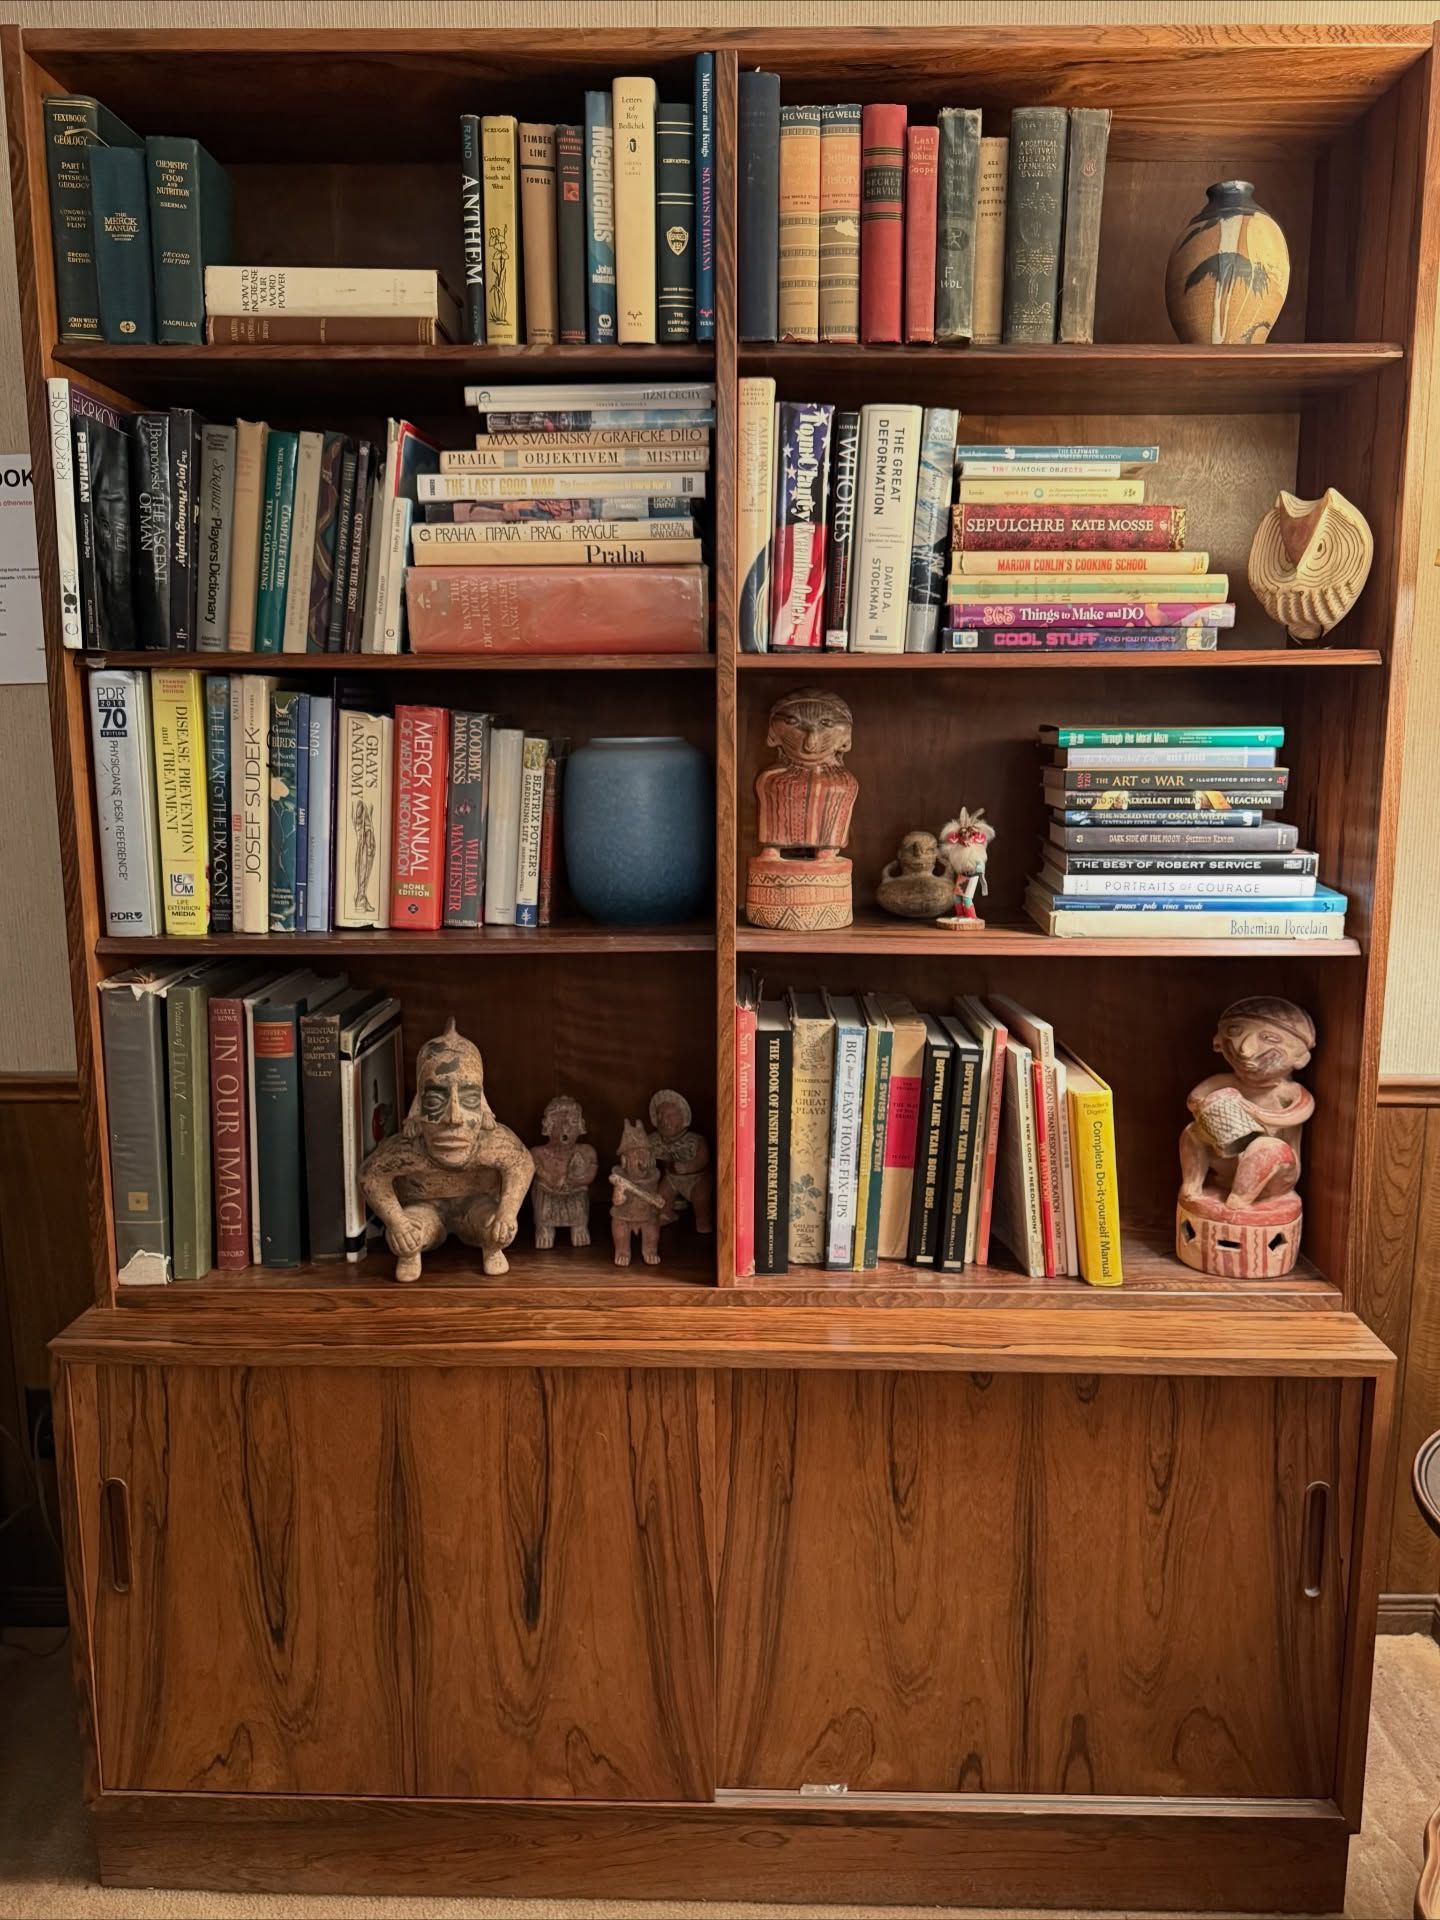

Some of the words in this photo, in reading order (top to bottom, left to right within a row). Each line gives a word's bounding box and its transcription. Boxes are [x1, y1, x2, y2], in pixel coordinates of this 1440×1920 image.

[621, 96, 643, 104] Letters
[53, 113, 87, 123] TEXTBOOK
[618, 122, 646, 130] Bedichek
[626, 113, 639, 121] Roy
[796, 113, 820, 121] WELLS
[836, 111, 861, 119] WELLS
[54, 134, 88, 146] GEOLOGY
[463, 124, 472, 159] RAND
[523, 134, 552, 144] TIMBER
[913, 136, 935, 145] Last
[155, 160, 188, 171] CHEMISTRY
[483, 156, 511, 164] Gardening
[529, 149, 547, 158] LINE
[162, 174, 184, 183] FOOD
[591, 126, 614, 243] Megatrends
[156, 187, 190, 198] NUTRITION
[104, 217, 138, 226] MERCK
[105, 225, 140, 233] MANUAL
[462, 175, 483, 285] ANTHEM
[595, 265, 613, 275] John
[250, 269, 259, 313] INCREASE
[259, 276, 268, 304] YOUR
[269, 274, 277, 308] WORD
[278, 273, 286, 309] POWER
[162, 320, 197, 328] MACMILLAN
[51, 391, 72, 481] KRKONOŠE
[895, 428, 905, 455] THE
[76, 431, 92, 504] PERMIAN
[448, 454, 497, 466] PRAHA
[524, 451, 619, 466] OBJEKTIVEM
[873, 420, 889, 516] DEFORMATION
[444, 478, 465, 496] THE
[468, 478, 496, 496] LAST
[499, 478, 528, 496] GOOD
[530, 478, 556, 496] WAR
[834, 436, 858, 543] WHORES
[890, 458, 903, 503] GREAT
[138, 492, 151, 511] OF
[265, 499, 273, 530] TEXAS
[140, 514, 153, 551] MAN
[435, 528, 477, 543] PRAHA
[530, 526, 562, 541] PRAG
[571, 524, 619, 540] PRAGUE
[966, 519, 1065, 533] SEPULCHRE
[1071, 520, 1105, 532] KATE
[1108, 519, 1154, 532] MOSSE
[209, 518, 223, 562] Players
[261, 533, 271, 591] GARDENING
[584, 544, 646, 565] Praha
[997, 559, 1031, 572] MARION
[1033, 558, 1073, 572] CONLIN'S
[1075, 558, 1114, 571] COOKING
[1115, 558, 1149, 571] SCHOOL
[204, 563, 222, 625] Dictionary
[868, 558, 882, 620] STOCKMAN
[882, 566, 894, 598] DAVID
[480, 580, 493, 648] DICTIONARY
[882, 602, 892, 613] A.
[983, 606, 1016, 625] 365
[1019, 607, 1060, 624] Things
[1061, 610, 1070, 619] to
[1071, 607, 1104, 620] Make
[1106, 608, 1121, 619] and
[1122, 607, 1144, 620] DO
[97, 687, 126, 700] PDR
[98, 708, 127, 729] 70
[400, 719, 413, 736] OF
[161, 726, 173, 746] and
[176, 706, 190, 764] DISEASE
[271, 736, 297, 748] BIRDS
[351, 719, 365, 800] ANATOMY
[365, 735, 380, 788] GRAY'S
[412, 720, 433, 788] MERCK
[453, 715, 468, 785] DARKNESS
[244, 728, 261, 806] SUDEK
[399, 738, 413, 791] MEDICAL
[163, 749, 179, 833] TREATMENT
[1111, 775, 1139, 787] ART
[1154, 775, 1185, 786] WAR
[113, 800, 124, 823] DESK
[178, 768, 195, 855] PREVENTION
[530, 775, 542, 823] BEATRIX
[1226, 796, 1272, 805] MEACHAM
[244, 810, 262, 882] JOSEF
[397, 794, 412, 876] INFORMATION
[411, 792, 431, 876] MANUAL
[116, 825, 128, 878] REFERENCE
[528, 825, 541, 878] POTTER'S
[449, 823, 464, 912] MANCHESTER
[463, 838, 479, 897] WILLIAM
[1075, 861, 1099, 869] THE
[1103, 861, 1133, 869] BEST
[1136, 861, 1154, 869] OF
[1156, 861, 1207, 869] ROBERT
[1209, 861, 1262, 869] SERVICE
[403, 883, 425, 891] HOME
[1104, 881, 1175, 892] PORTRAITS
[1197, 882, 1261, 893] COURAGE
[110, 911, 135, 921] PDR
[1230, 919, 1280, 936] Bohemian
[1285, 919, 1329, 936] Porcelain
[214, 1034, 238, 1063] IN
[307, 1036, 330, 1044] RUGS
[739, 1032, 752, 1055] San
[769, 1038, 781, 1060] THE
[768, 1063, 780, 1092] BOOK
[880, 1056, 890, 1079] THE
[933, 1059, 946, 1101] BOTTOM
[738, 1060, 751, 1109] Antonio
[800, 1089, 822, 1097] TEN
[961, 1063, 975, 1105] BOTTOM
[216, 1075, 241, 1137] OUR
[768, 1094, 779, 1107] OF
[796, 1107, 827, 1116] PLAYS
[876, 1083, 888, 1120] SWISS
[767, 1109, 779, 1144] INSIDE
[931, 1103, 942, 1126] LINE
[959, 1107, 972, 1131] LINE
[873, 1123, 886, 1173] SYSTEM
[928, 1129, 940, 1155] YEAR
[957, 1134, 969, 1160] YEAR
[766, 1147, 779, 1220] INFORMATION
[926, 1158, 938, 1184] BOOK
[954, 1163, 966, 1190] BOOK
[217, 1147, 243, 1237] IMAGE
[1093, 1120, 1104, 1170] Complete
[1099, 1240, 1113, 1279] Manual
